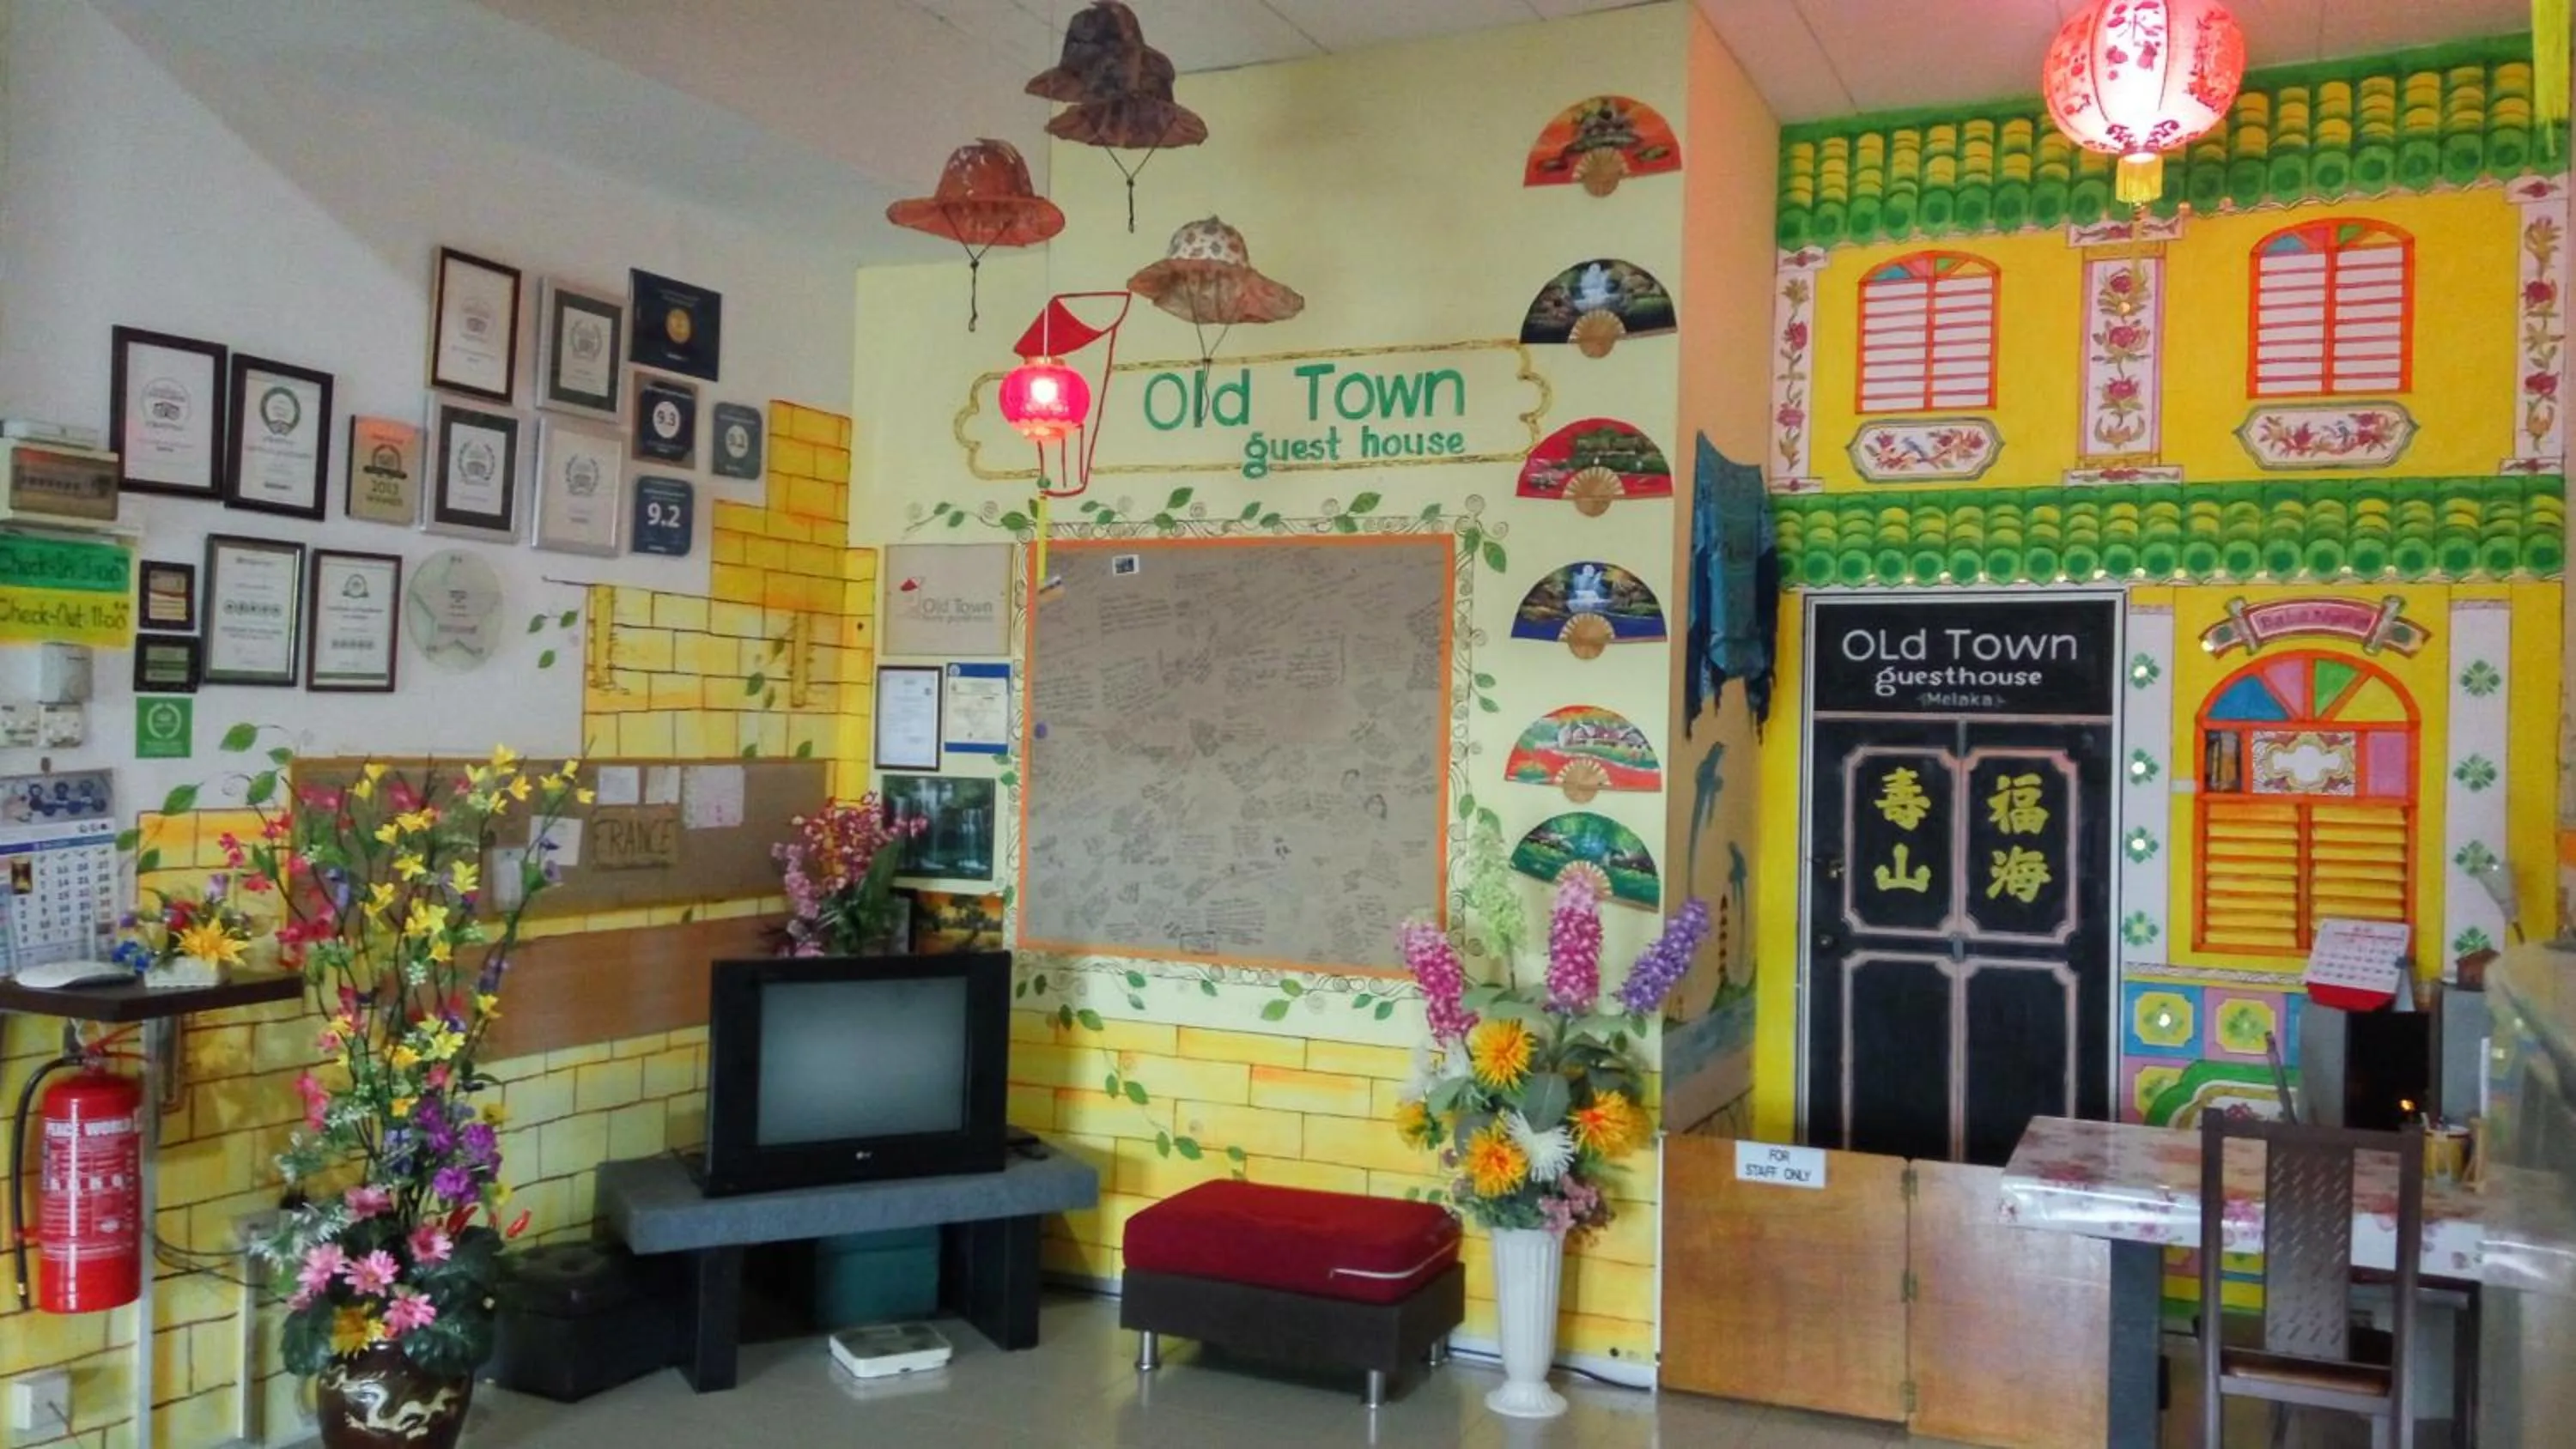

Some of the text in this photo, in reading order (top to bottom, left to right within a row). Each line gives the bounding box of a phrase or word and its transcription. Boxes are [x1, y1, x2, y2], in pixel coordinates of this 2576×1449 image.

[1144, 362, 1466, 431] Old Town
[657, 409, 677, 427] 9.3
[1242, 426, 1466, 479] guest house
[647, 502, 681, 528] 9.2
[922, 597, 993, 615] Old Town
[1944, 628, 2077, 661] Town
[1874, 666, 2043, 697] guesthouse
[1986, 773, 2052, 903] 福海
[1769, 1149, 1790, 1163] FOR
[1745, 1162, 1812, 1182] STAFF ONLY
